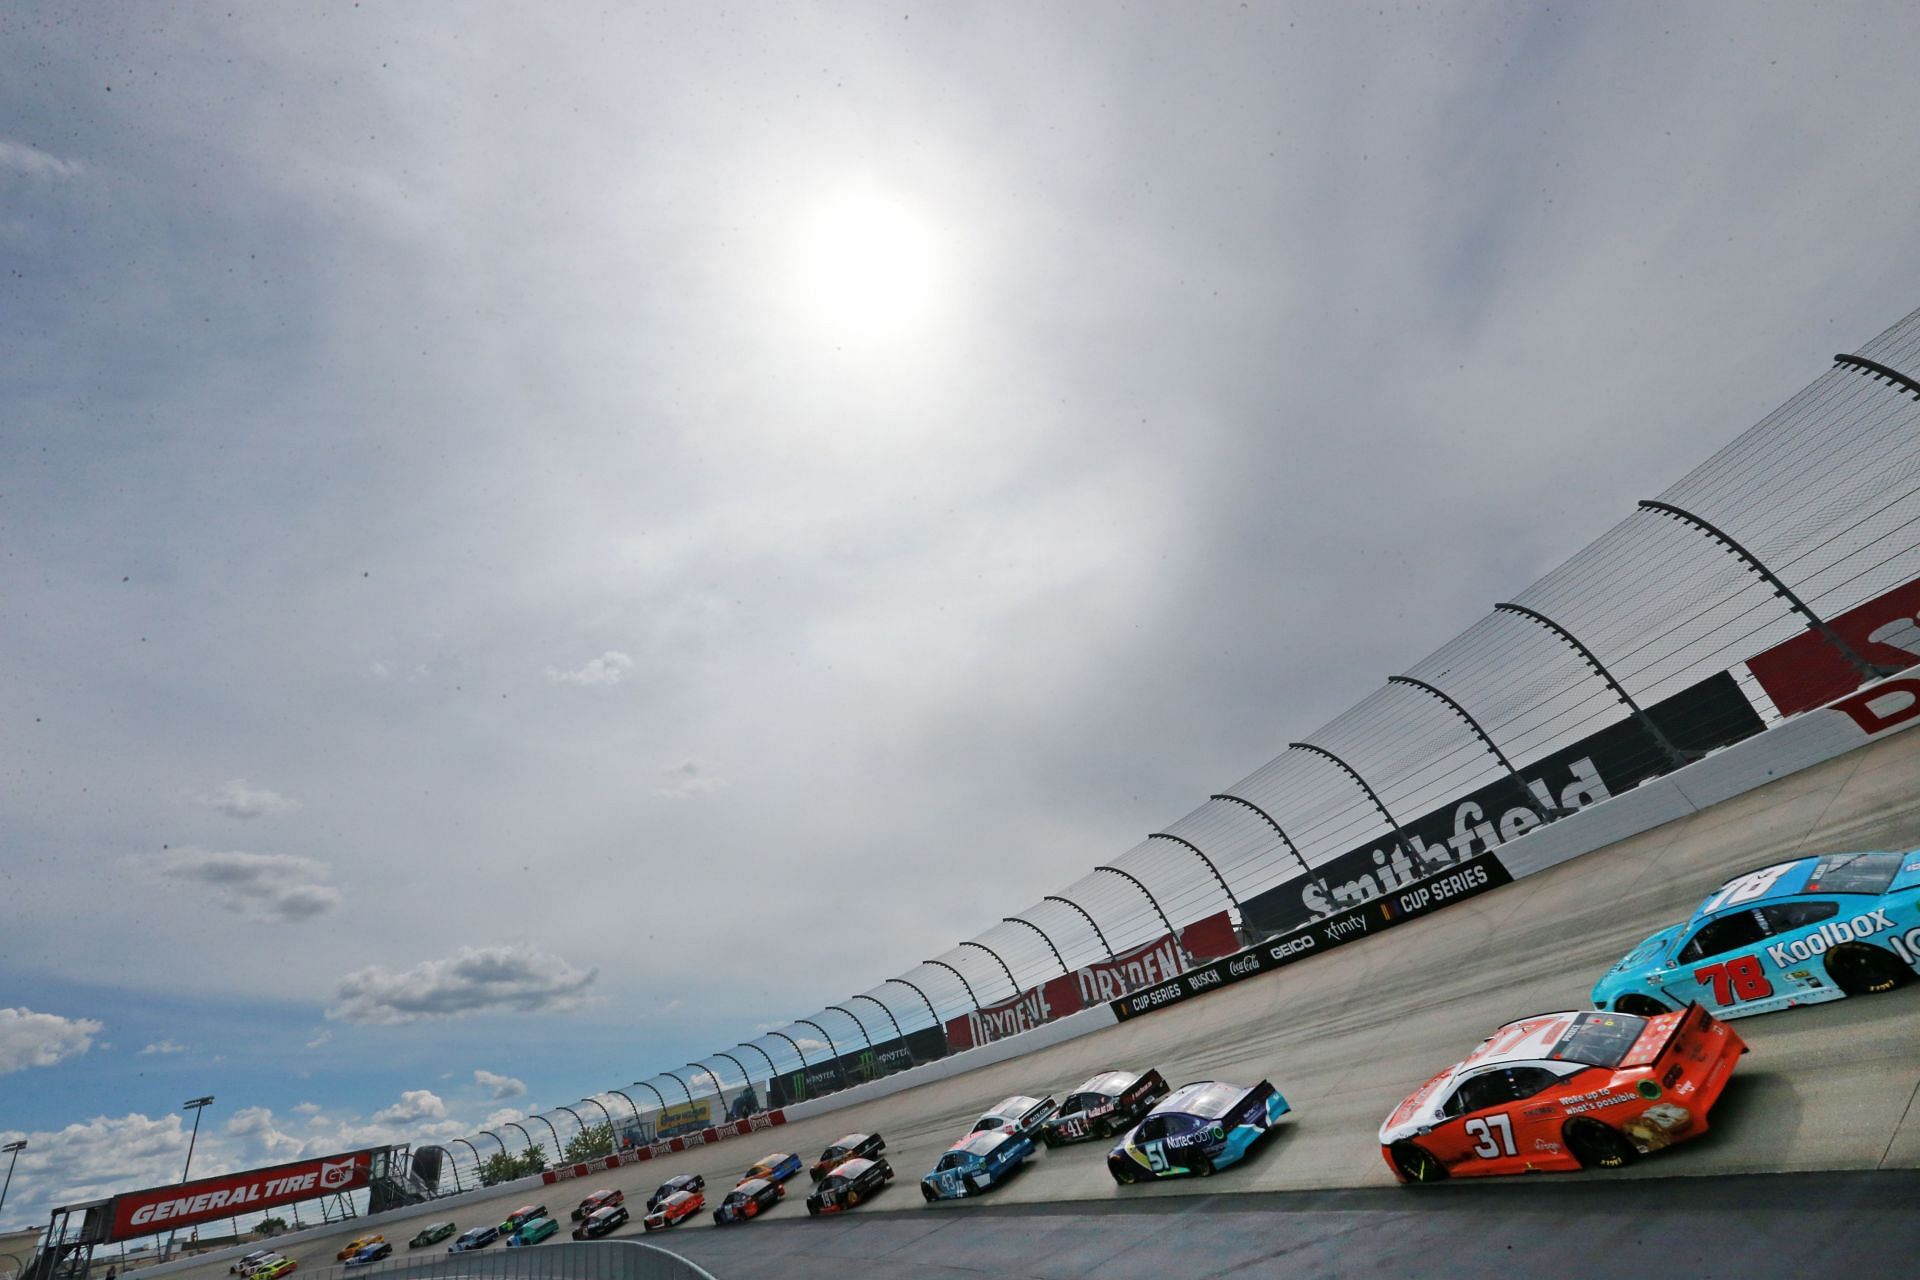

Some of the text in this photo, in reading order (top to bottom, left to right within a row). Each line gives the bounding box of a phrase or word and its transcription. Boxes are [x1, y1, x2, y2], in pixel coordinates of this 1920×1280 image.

[1302, 756, 1611, 920] Smithfield
[1400, 865, 1488, 912] CUP SERIES
[1323, 914, 1367, 940] xfinity
[1767, 908, 1896, 968] Koolbox
[1270, 935, 1315, 960] GEICO
[1187, 969, 1220, 990] BUSCH
[1694, 955, 1773, 1006] 78
[1132, 983, 1181, 1012] CUP SERIES
[1559, 1088, 1610, 1106] Wake up to
[1564, 1102, 1595, 1115] what's
[1067, 1119, 1084, 1137] 41
[1465, 1113, 1517, 1158] 37
[1145, 1139, 1169, 1171] 51
[941, 1173, 956, 1191] 43
[130, 1184, 261, 1225] GENERAL
[264, 1172, 319, 1198] TIRE
